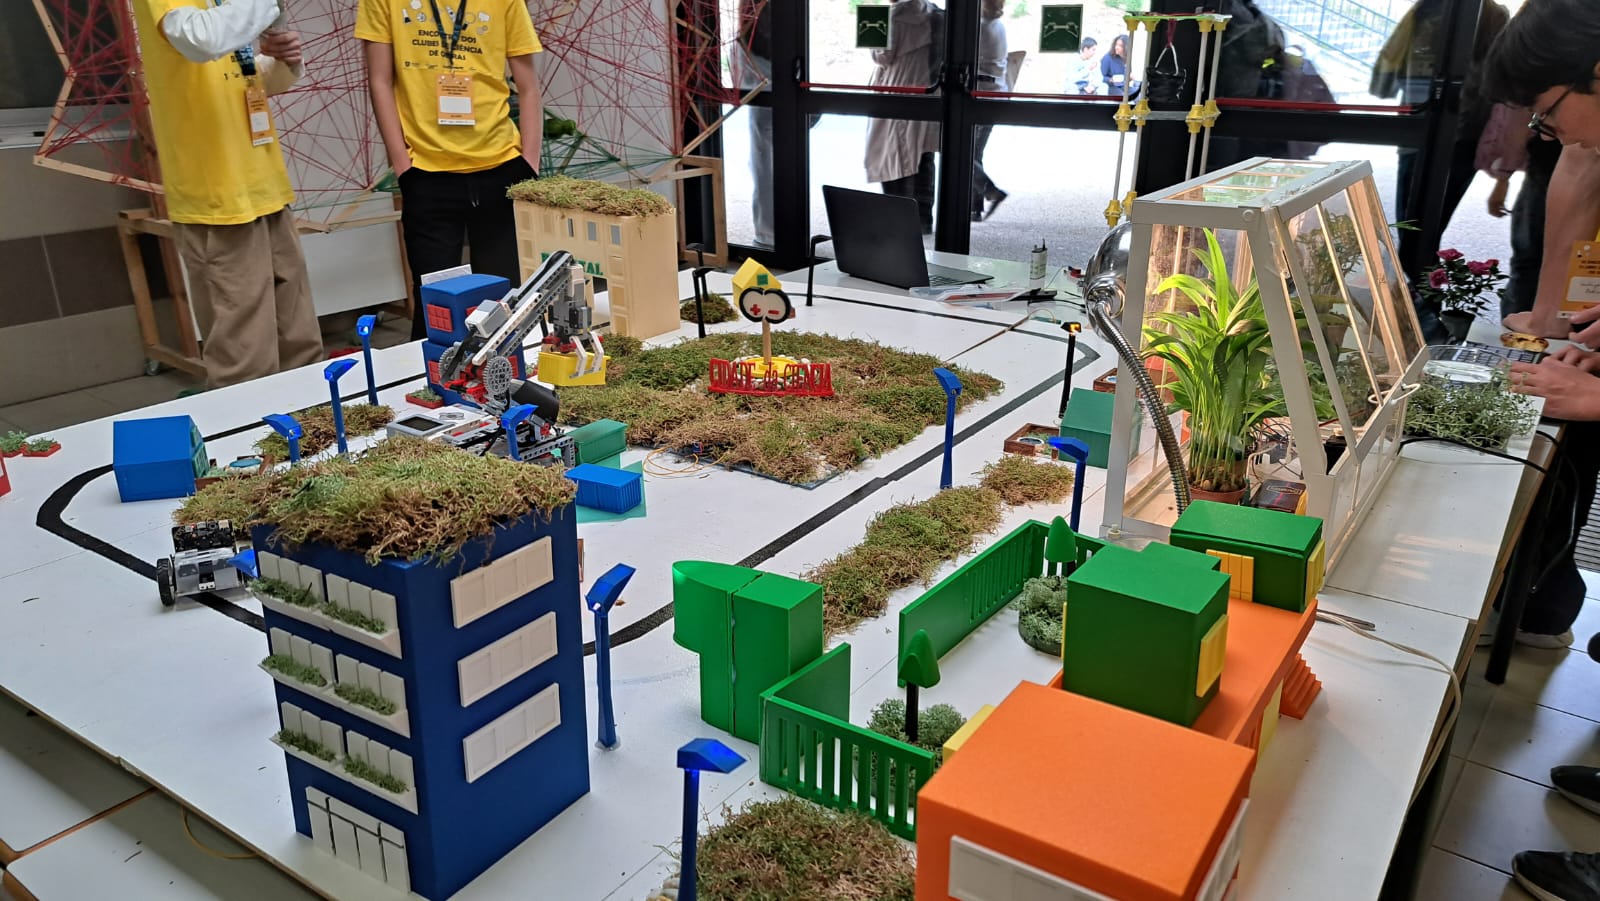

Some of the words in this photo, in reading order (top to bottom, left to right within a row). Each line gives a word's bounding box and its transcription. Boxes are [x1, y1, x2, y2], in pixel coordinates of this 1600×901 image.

[412, 39, 439, 47] CLUBES
[461, 35, 477, 43] DOS
[441, 51, 466, 60] ORAS
[541, 252, 604, 276] PTAL
[710, 358, 755, 389] CIDADE
[764, 361, 778, 391] da
